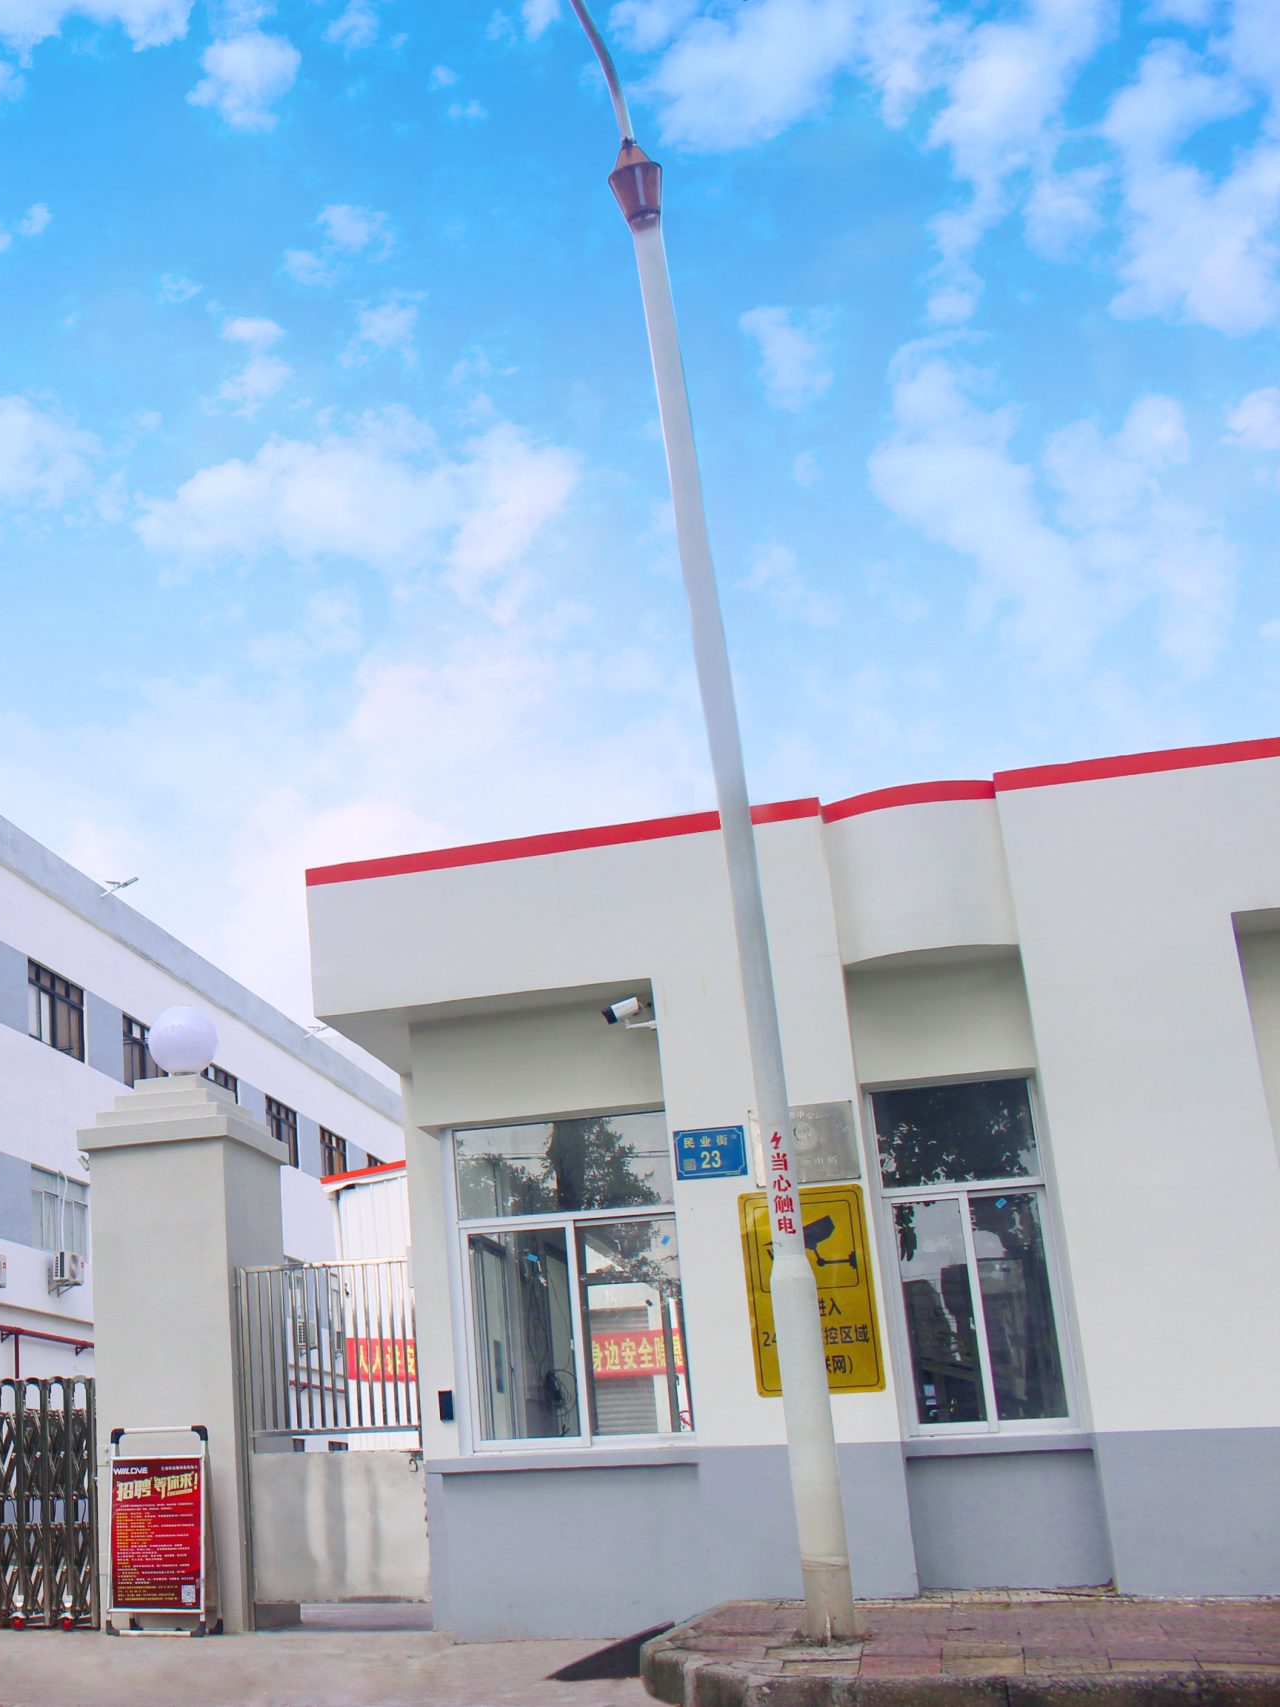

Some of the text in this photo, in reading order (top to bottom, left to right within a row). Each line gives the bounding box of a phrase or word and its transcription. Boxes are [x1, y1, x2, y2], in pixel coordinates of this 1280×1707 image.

[700, 1149, 722, 1169] 23
[770, 1151, 797, 1236] 当心触电
